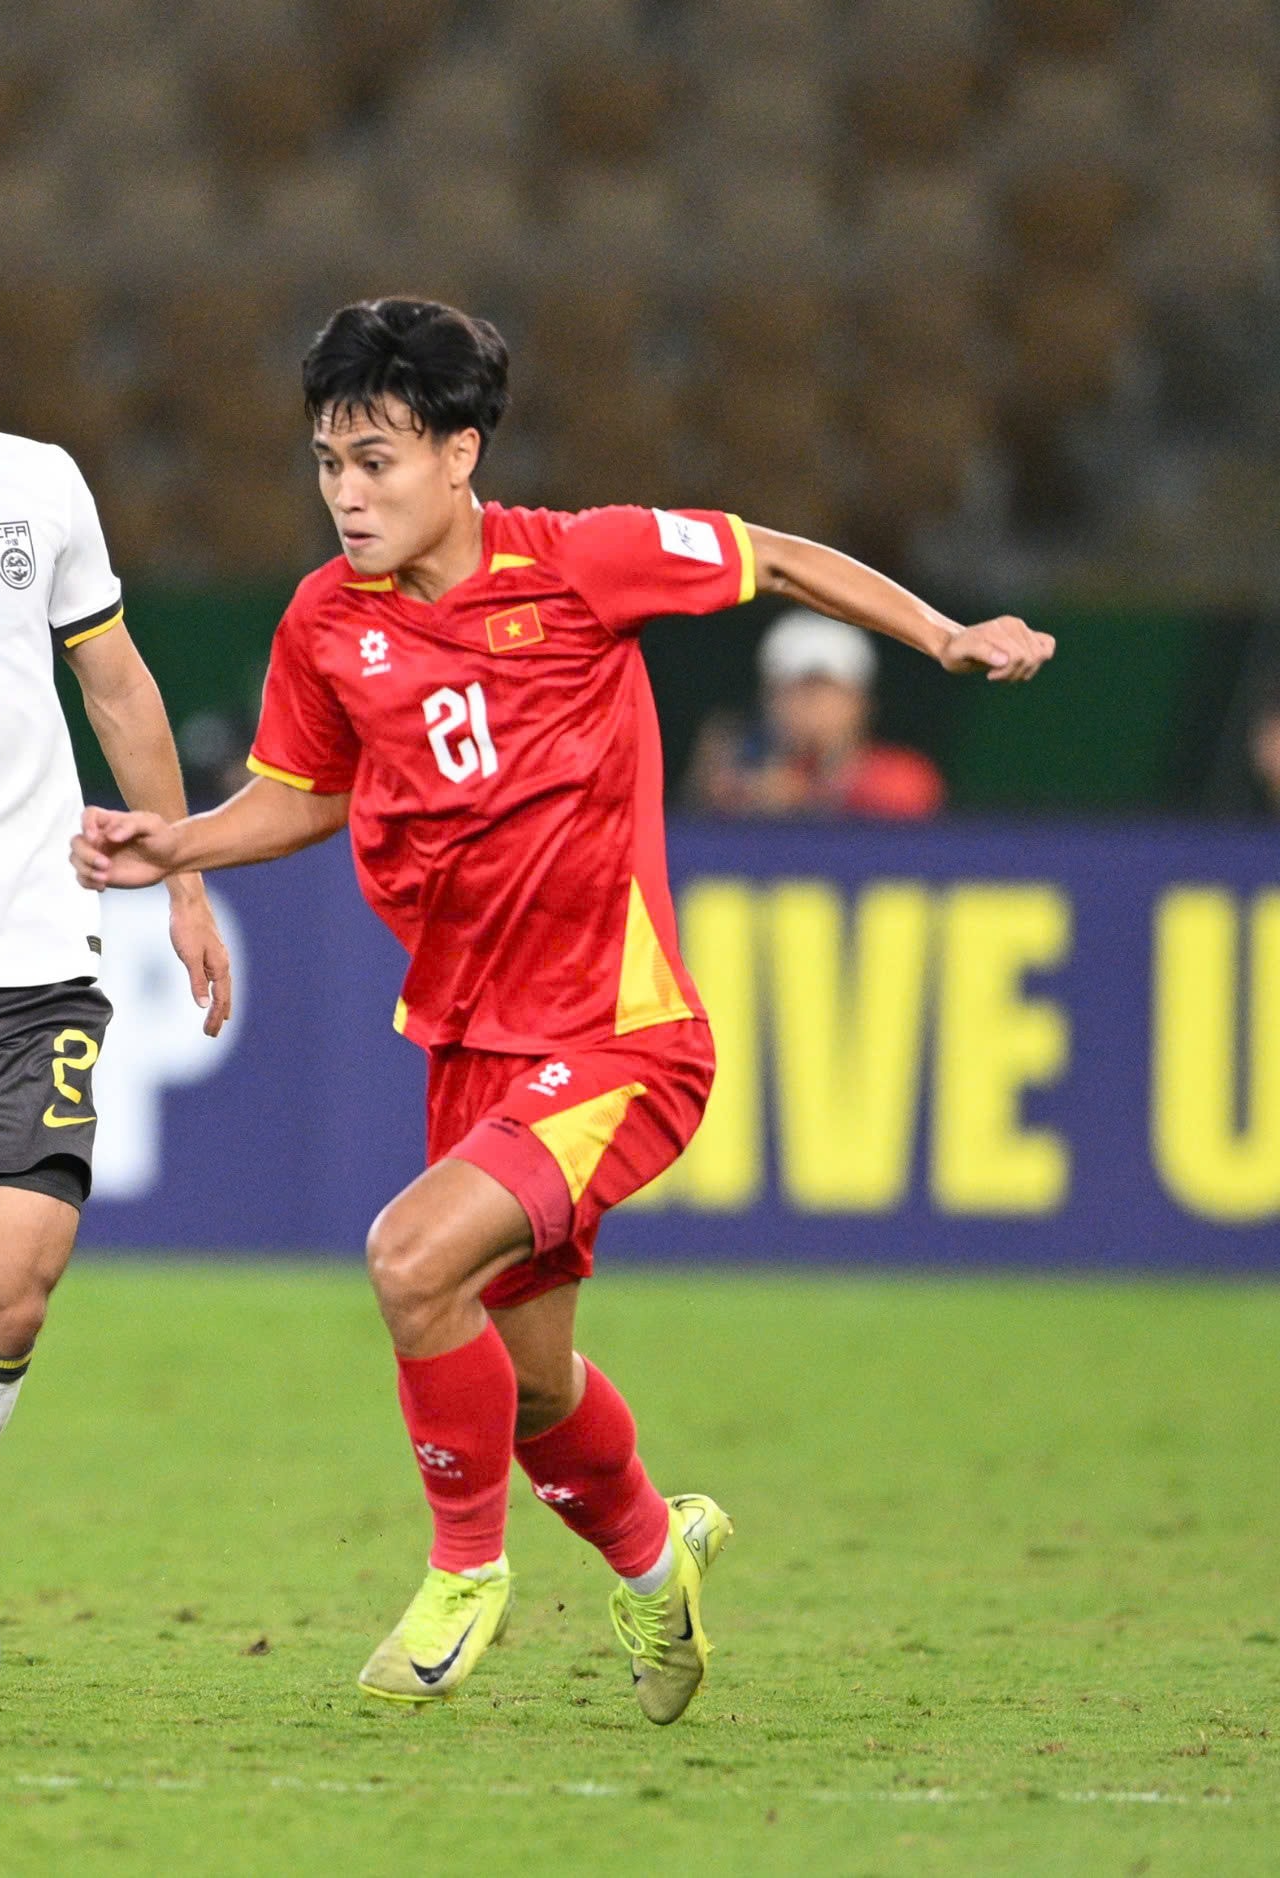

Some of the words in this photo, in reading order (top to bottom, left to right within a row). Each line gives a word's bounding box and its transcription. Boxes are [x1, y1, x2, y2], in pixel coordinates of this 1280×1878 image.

[421, 681, 499, 785] 21
[52, 1028, 99, 1105] 2
[605, 878, 1072, 1216] IVE
